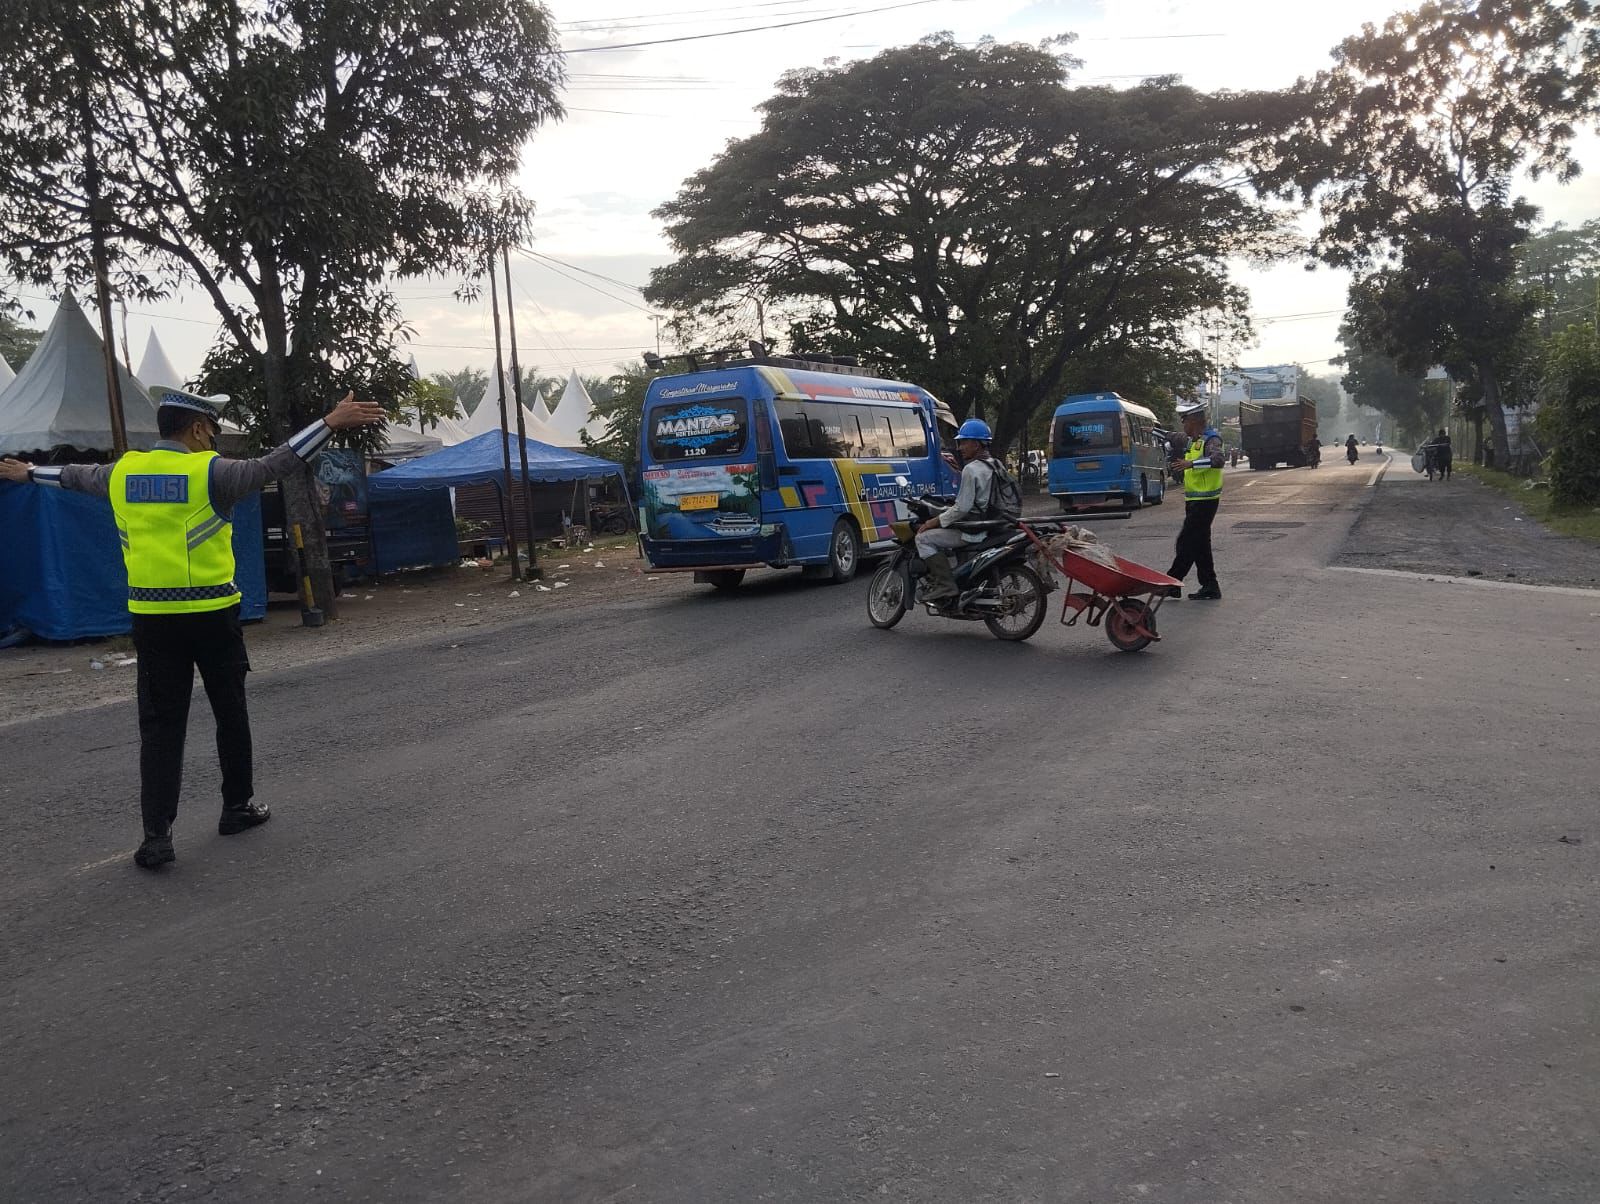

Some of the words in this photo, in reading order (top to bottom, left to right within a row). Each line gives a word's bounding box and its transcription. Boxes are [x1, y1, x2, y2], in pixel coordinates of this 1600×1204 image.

[684, 447, 707, 456] 1120
[127, 478, 186, 500] POLISI
[860, 488, 870, 498] PT
[872, 485, 898, 498] DANAU
